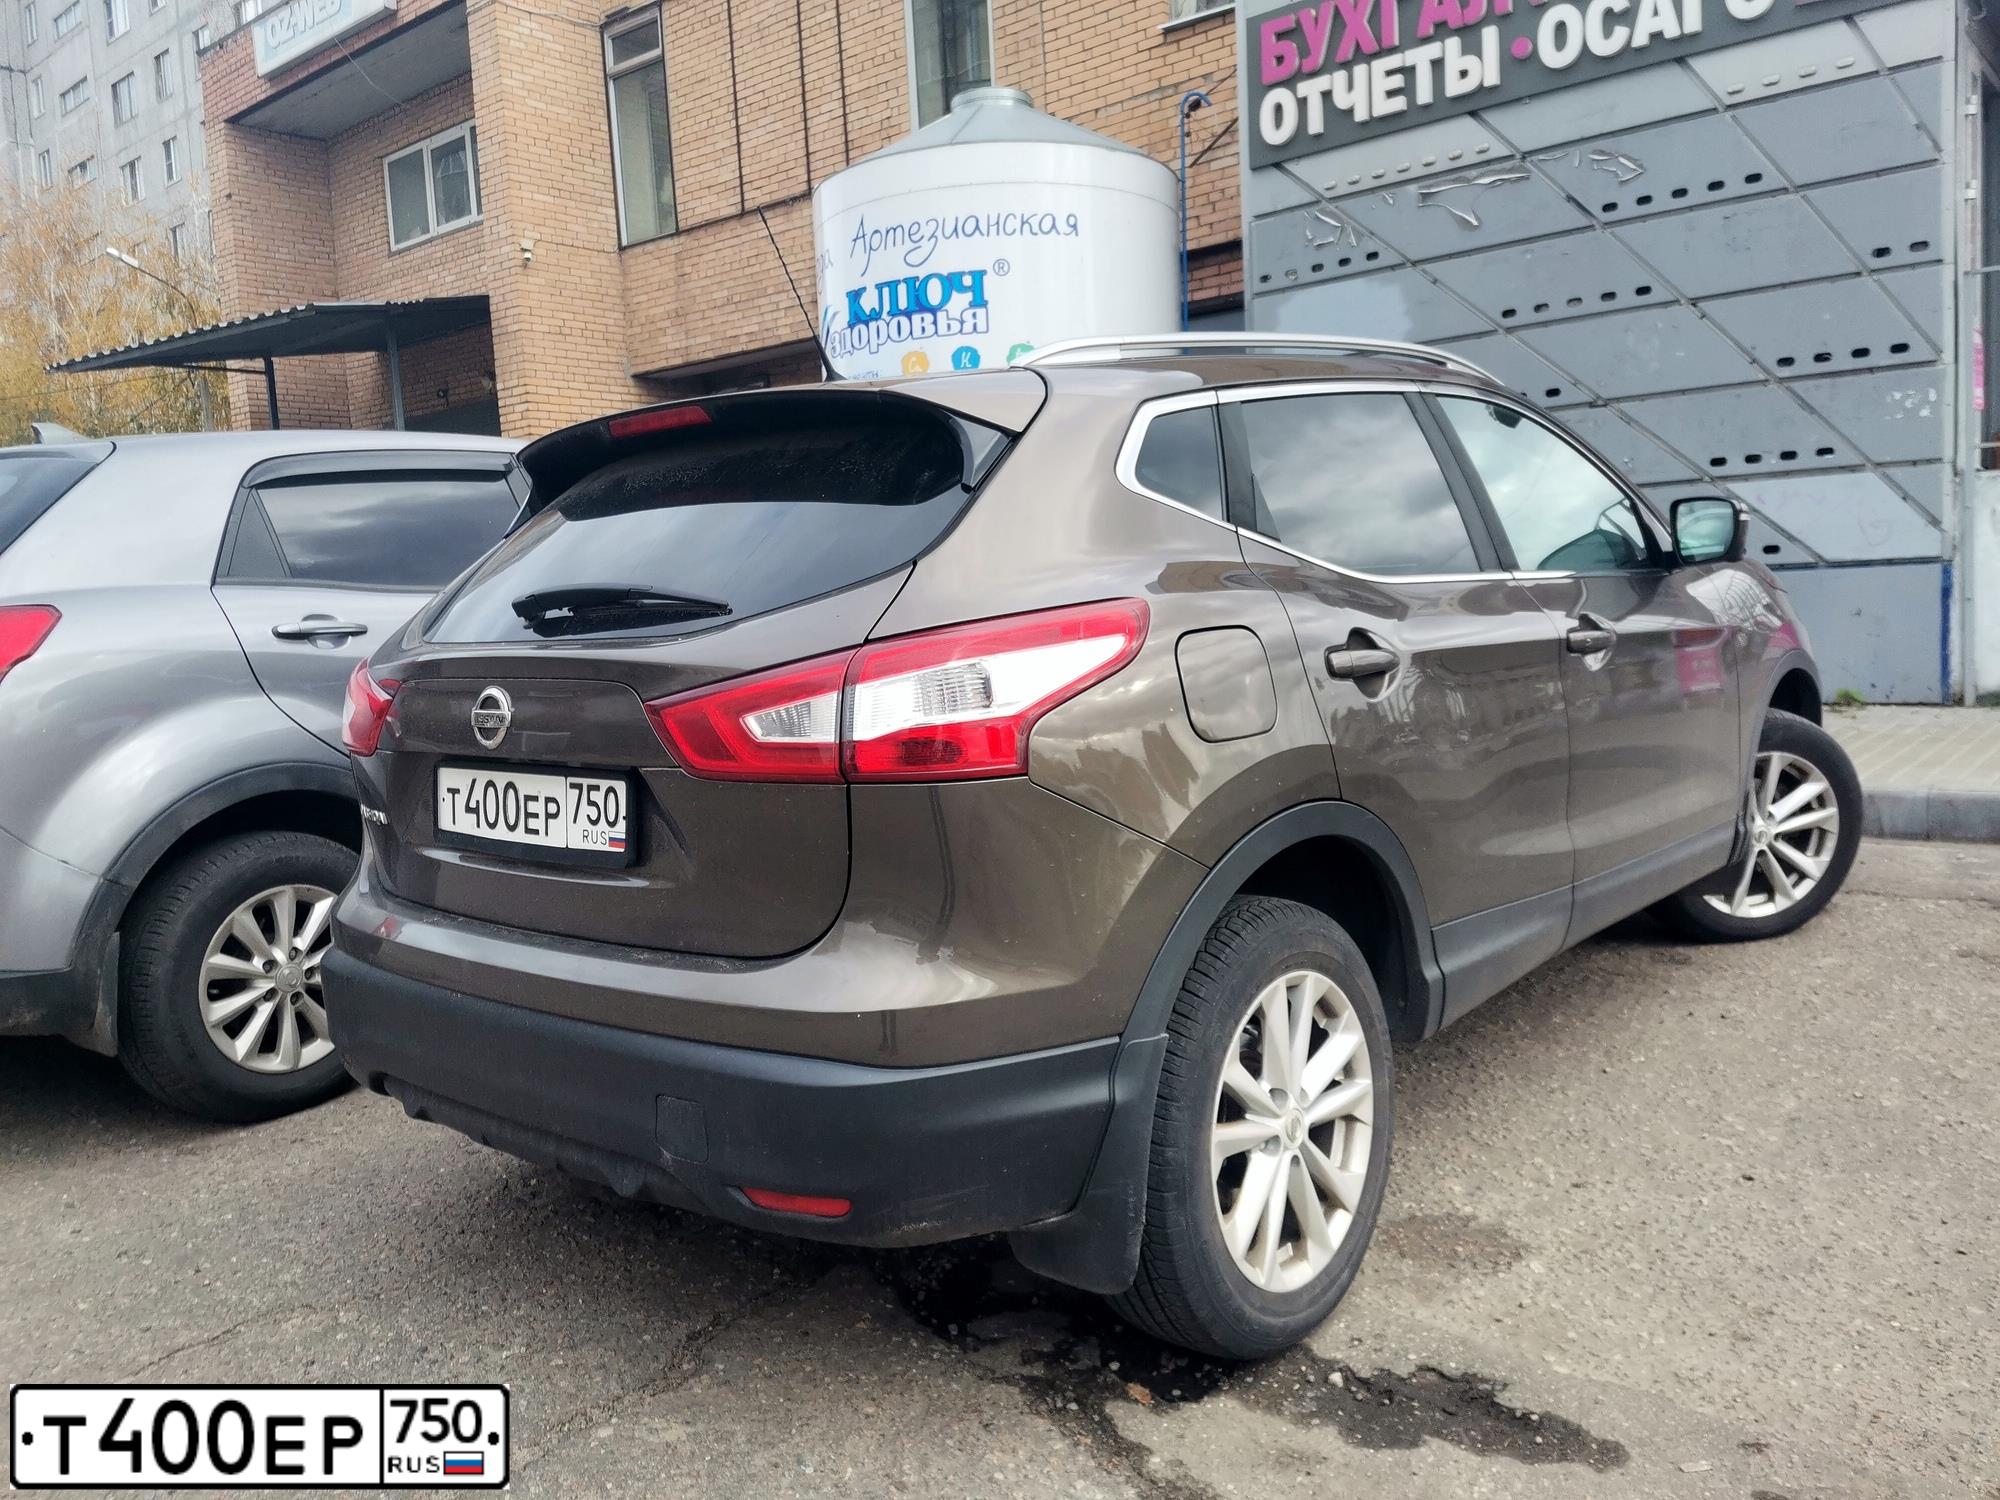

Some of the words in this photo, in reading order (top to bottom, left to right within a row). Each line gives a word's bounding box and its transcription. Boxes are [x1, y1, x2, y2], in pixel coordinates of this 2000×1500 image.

[1259, 25, 1501, 146] ОТЧЕТЫ
[850, 212, 1079, 277] Артезианская
[846, 268, 988, 326] КЛЮЧ
[569, 782, 620, 828] 750
[583, 829, 608, 846] RUS
